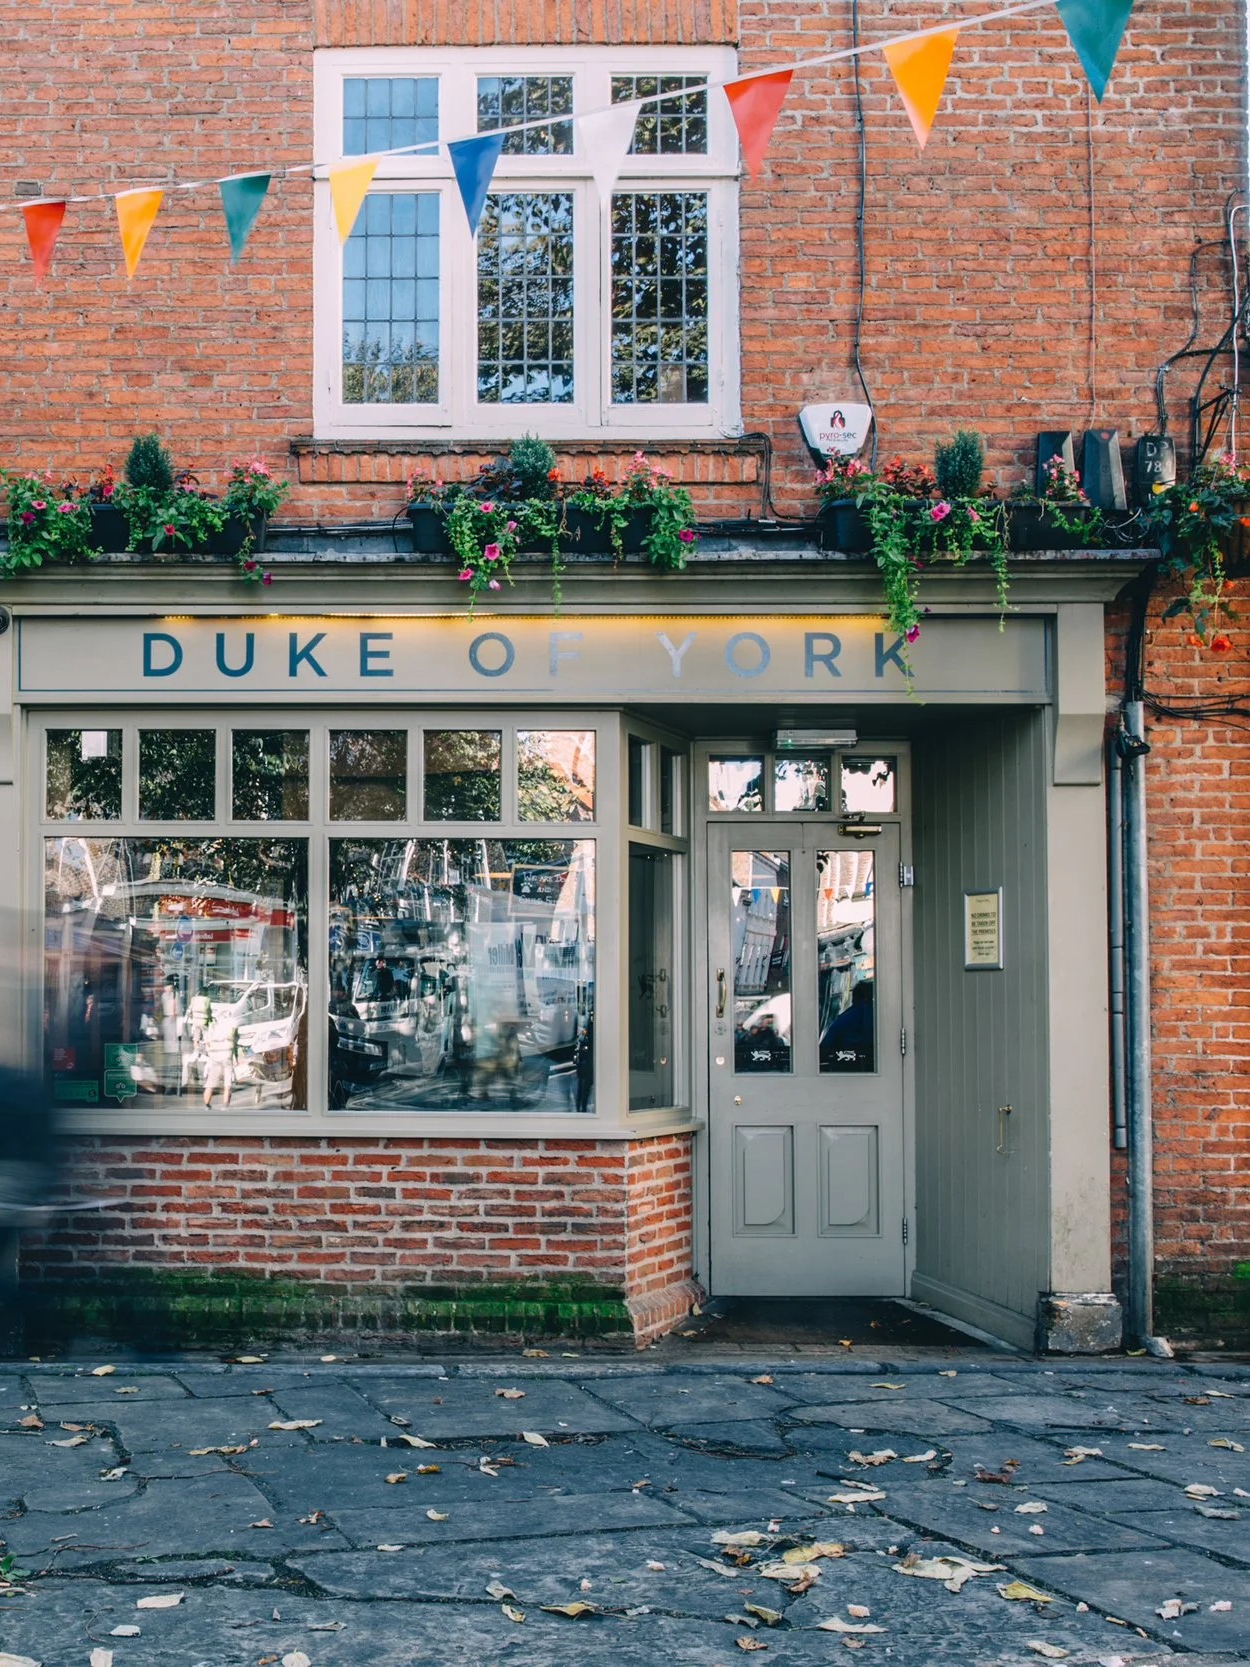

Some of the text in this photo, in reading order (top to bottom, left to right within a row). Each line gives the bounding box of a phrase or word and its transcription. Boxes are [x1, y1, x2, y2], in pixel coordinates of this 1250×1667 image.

[819, 432, 857, 441] pyro-sec
[142, 632, 916, 678] DUKE OF YORK
